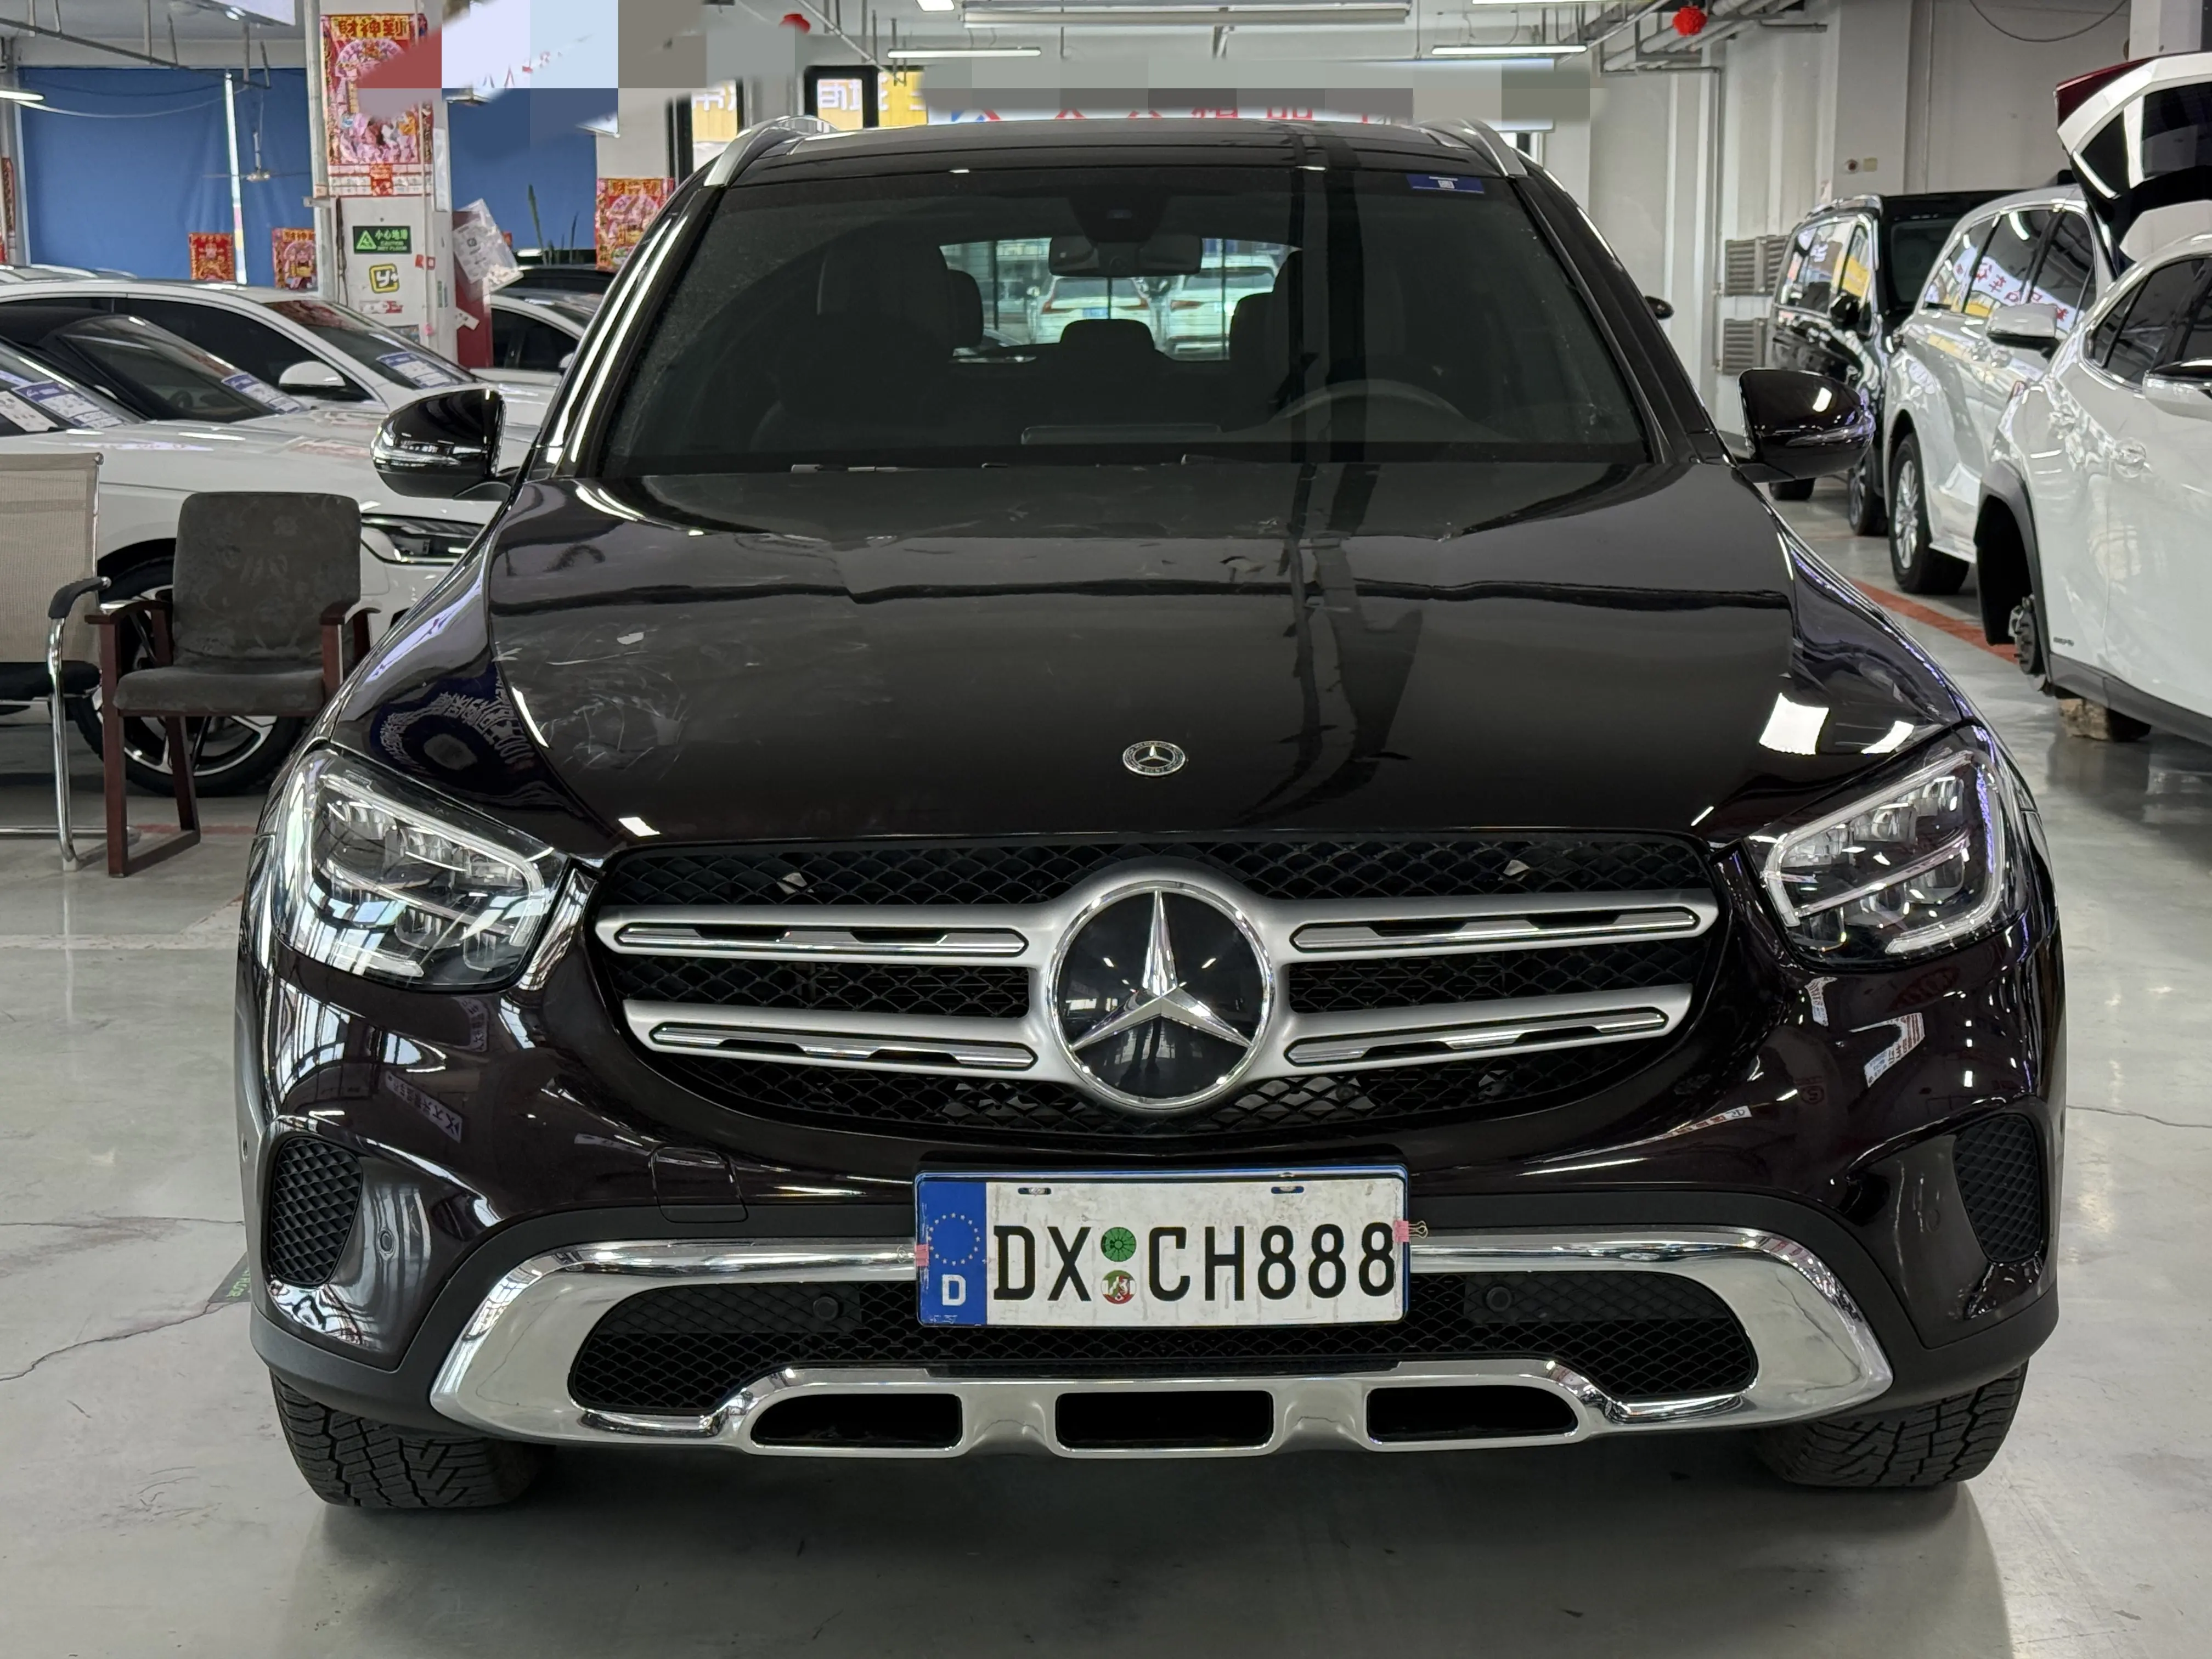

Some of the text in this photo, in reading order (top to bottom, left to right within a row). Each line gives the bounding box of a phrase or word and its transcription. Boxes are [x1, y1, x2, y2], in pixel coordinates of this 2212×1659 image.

[994, 1222, 1395, 1301] DX CH888
[942, 1274, 966, 1306] D
